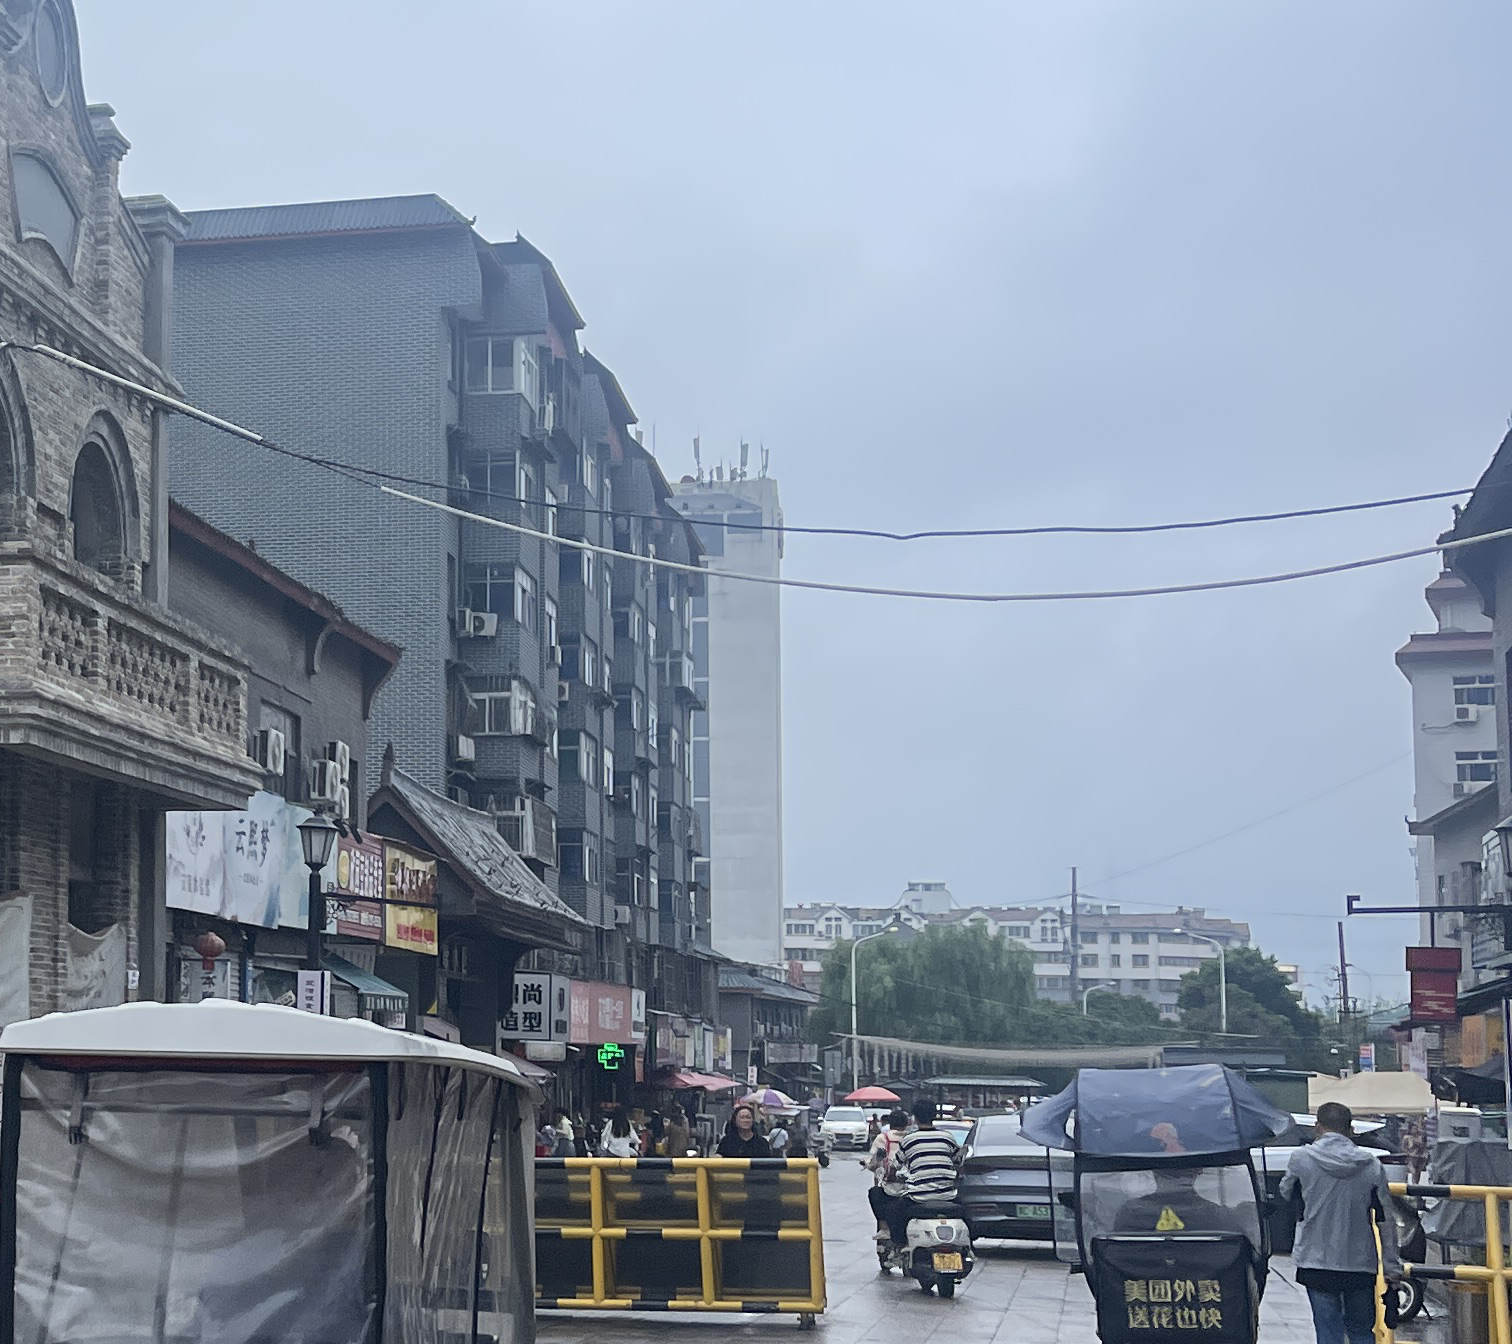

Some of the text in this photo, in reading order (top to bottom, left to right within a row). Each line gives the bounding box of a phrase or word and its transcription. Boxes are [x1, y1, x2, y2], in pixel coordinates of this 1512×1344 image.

[514, 982, 543, 1005] 尚
[1124, 1278, 1221, 1303] 美团外卖
[1128, 1305, 1222, 1329] 送花也快
